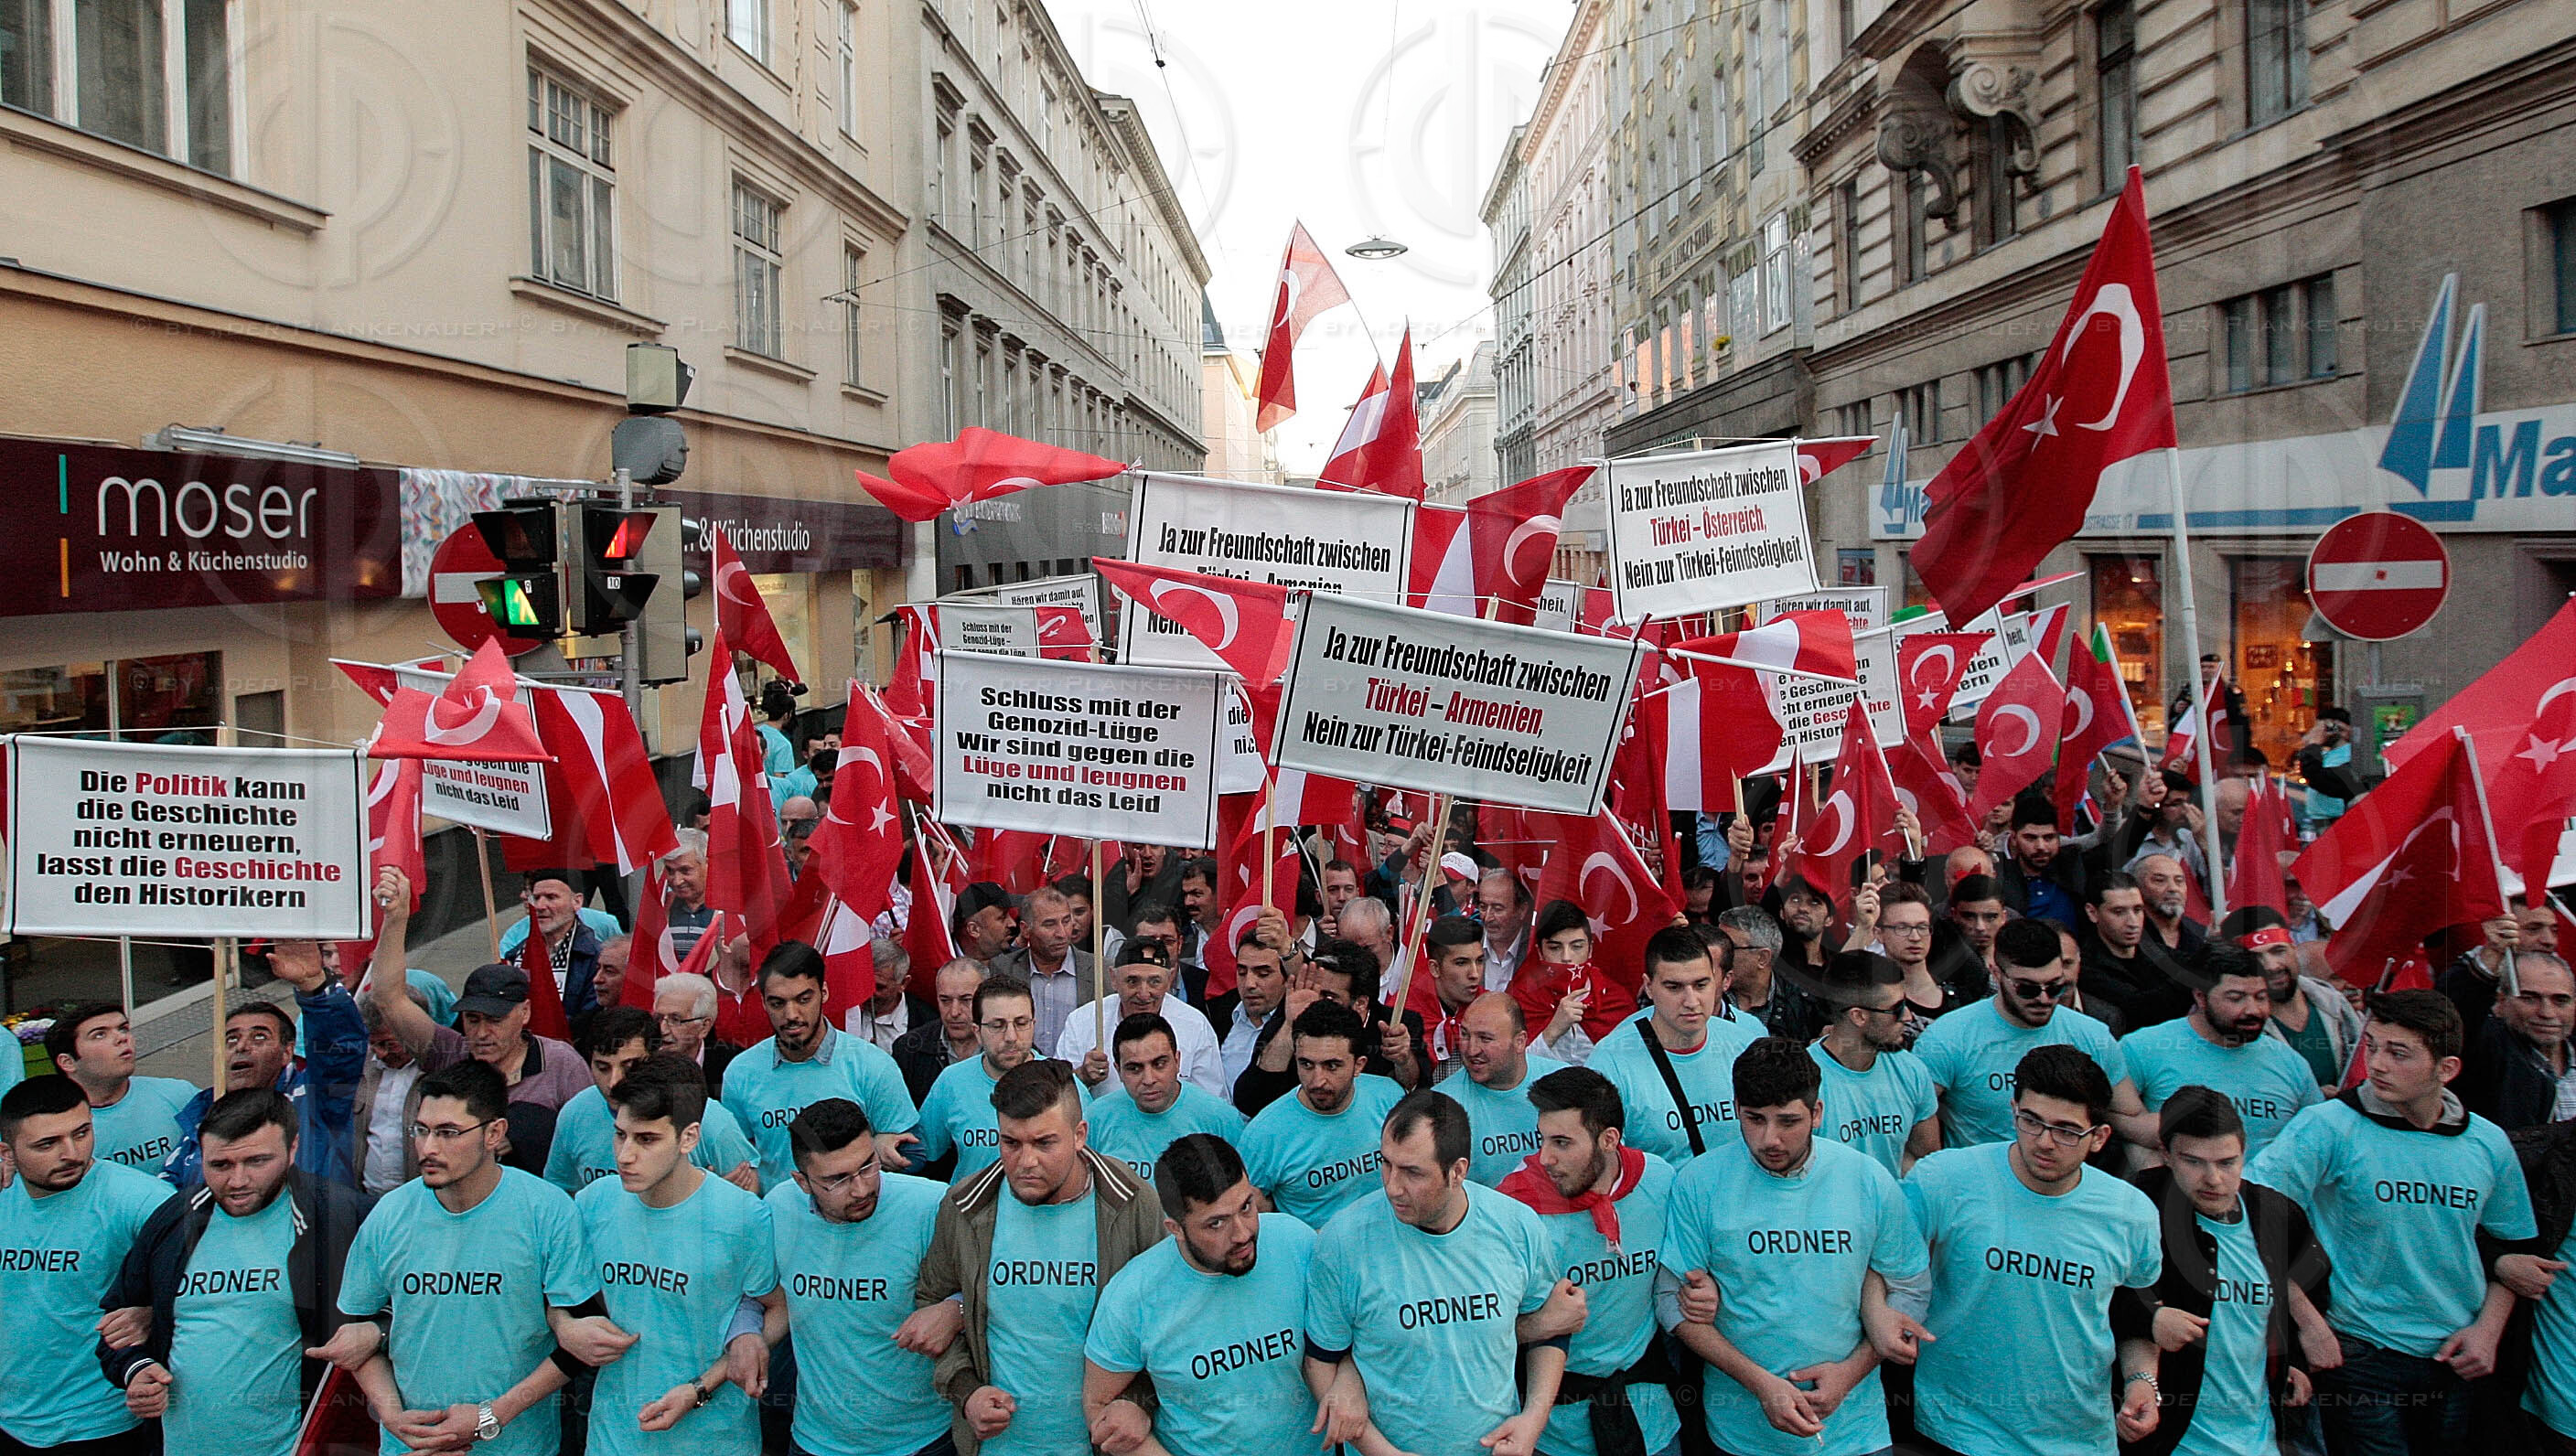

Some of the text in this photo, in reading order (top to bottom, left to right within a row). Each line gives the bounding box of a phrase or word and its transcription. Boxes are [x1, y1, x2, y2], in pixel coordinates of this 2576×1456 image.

[1620, 466, 1788, 513] Ja zur Freundschaft zwischen
[98, 476, 317, 539] moser
[1650, 514, 1691, 547] Türkei
[1702, 504, 1767, 540] Österreich,
[100, 551, 308, 573] Wohn & Küchenstudio
[1158, 521, 1176, 553] Ja
[1178, 528, 1207, 556] zur
[1208, 527, 1316, 566] Freundschaft
[1317, 541, 1391, 573] zwischen
[1625, 535, 1803, 590] Nein zur Türkei-Feindseligkeit
[609, 578, 620, 588] 10
[1048, 588, 1070, 603] damit
[1775, 599, 1803, 614] Hören
[1805, 599, 1821, 612] wir
[962, 622, 1012, 634] Schluss mit der
[1324, 626, 1612, 702] Ja zur Freundschaft zwischen
[981, 687, 1181, 720] Schluss mit der
[1365, 677, 1431, 718] Türkei
[1444, 691, 1544, 739] Armenien,
[988, 711, 1159, 744] Genozid-Lüge
[1788, 717, 1810, 730] die
[956, 732, 1195, 768] Wir sind gegen die
[1302, 711, 1592, 786] Nein zur Türkei-Feindseligkeit
[80, 770, 306, 800] Die Politik kann
[449, 768, 472, 784] und
[474, 770, 530, 794] leugnen
[963, 755, 1187, 792] Lüge und leugnen
[435, 782, 520, 811] nicht das Leid
[986, 781, 1161, 814] nicht das Leid
[77, 798, 297, 827] die Geschichte
[73, 827, 301, 856] nicht erneuern,
[38, 853, 341, 882] lasst die Geschichte
[74, 883, 306, 908] den Historikern
[2375, 1181, 2478, 1210] ORDNER
[1748, 1230, 1852, 1254] ORDNER
[0, 1249, 80, 1272] RDNER
[993, 1261, 1097, 1287] ORDNER
[1567, 1248, 1657, 1287] ORDNER
[1985, 1247, 2095, 1290] ORDNER
[402, 1271, 502, 1295] ORDNER
[602, 1261, 689, 1296] ORDNER
[793, 1273, 887, 1302] ORDNER
[1399, 1292, 1502, 1330] ORDNER
[1191, 1328, 1297, 1381] ORDNER
